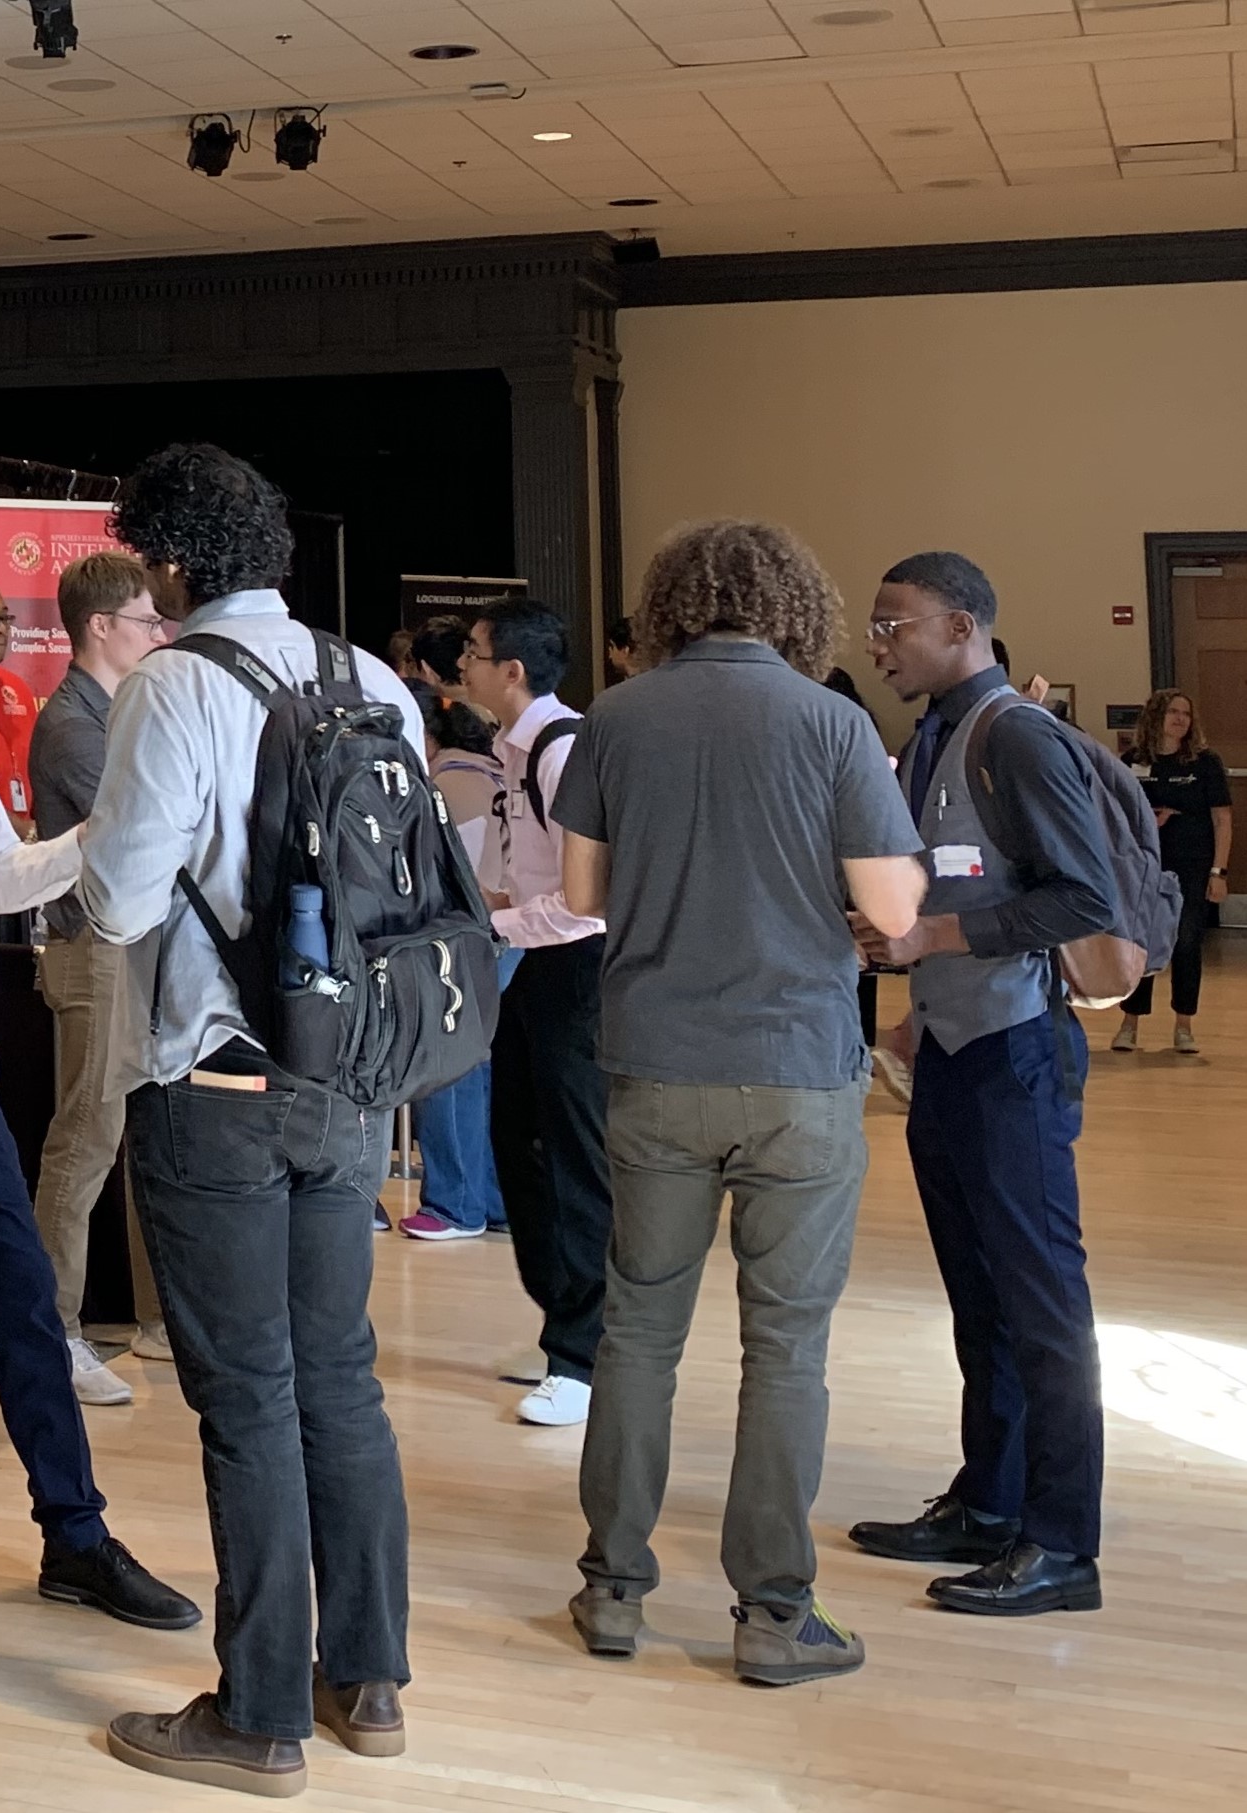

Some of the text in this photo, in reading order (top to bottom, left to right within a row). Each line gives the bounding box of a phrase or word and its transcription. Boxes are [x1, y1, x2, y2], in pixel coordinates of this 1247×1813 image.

[416, 594, 463, 605] LOCKHEED
[10, 625, 50, 641] Providing
[11, 640, 47, 655] Complex
